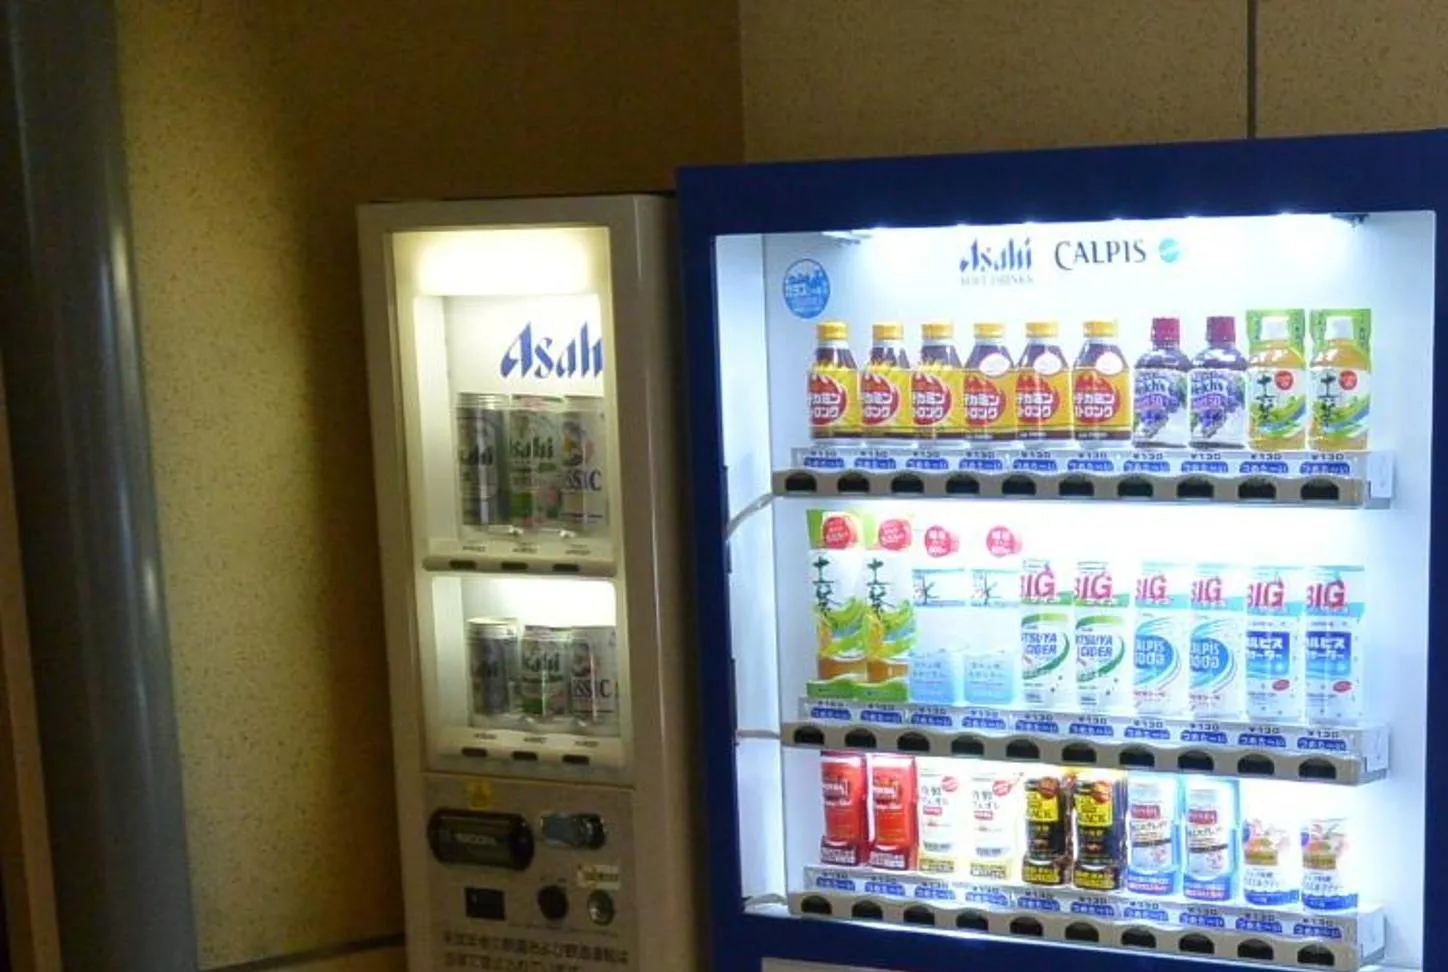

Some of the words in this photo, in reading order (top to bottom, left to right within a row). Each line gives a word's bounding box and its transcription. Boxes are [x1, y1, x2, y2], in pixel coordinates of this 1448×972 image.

[958, 237, 1033, 272] Asahi
[1054, 238, 1146, 270] CALPIS
[500, 320, 603, 380] Asah
[1248, 636, 1283, 650] ルピス
[1307, 637, 1345, 650] ルピス
